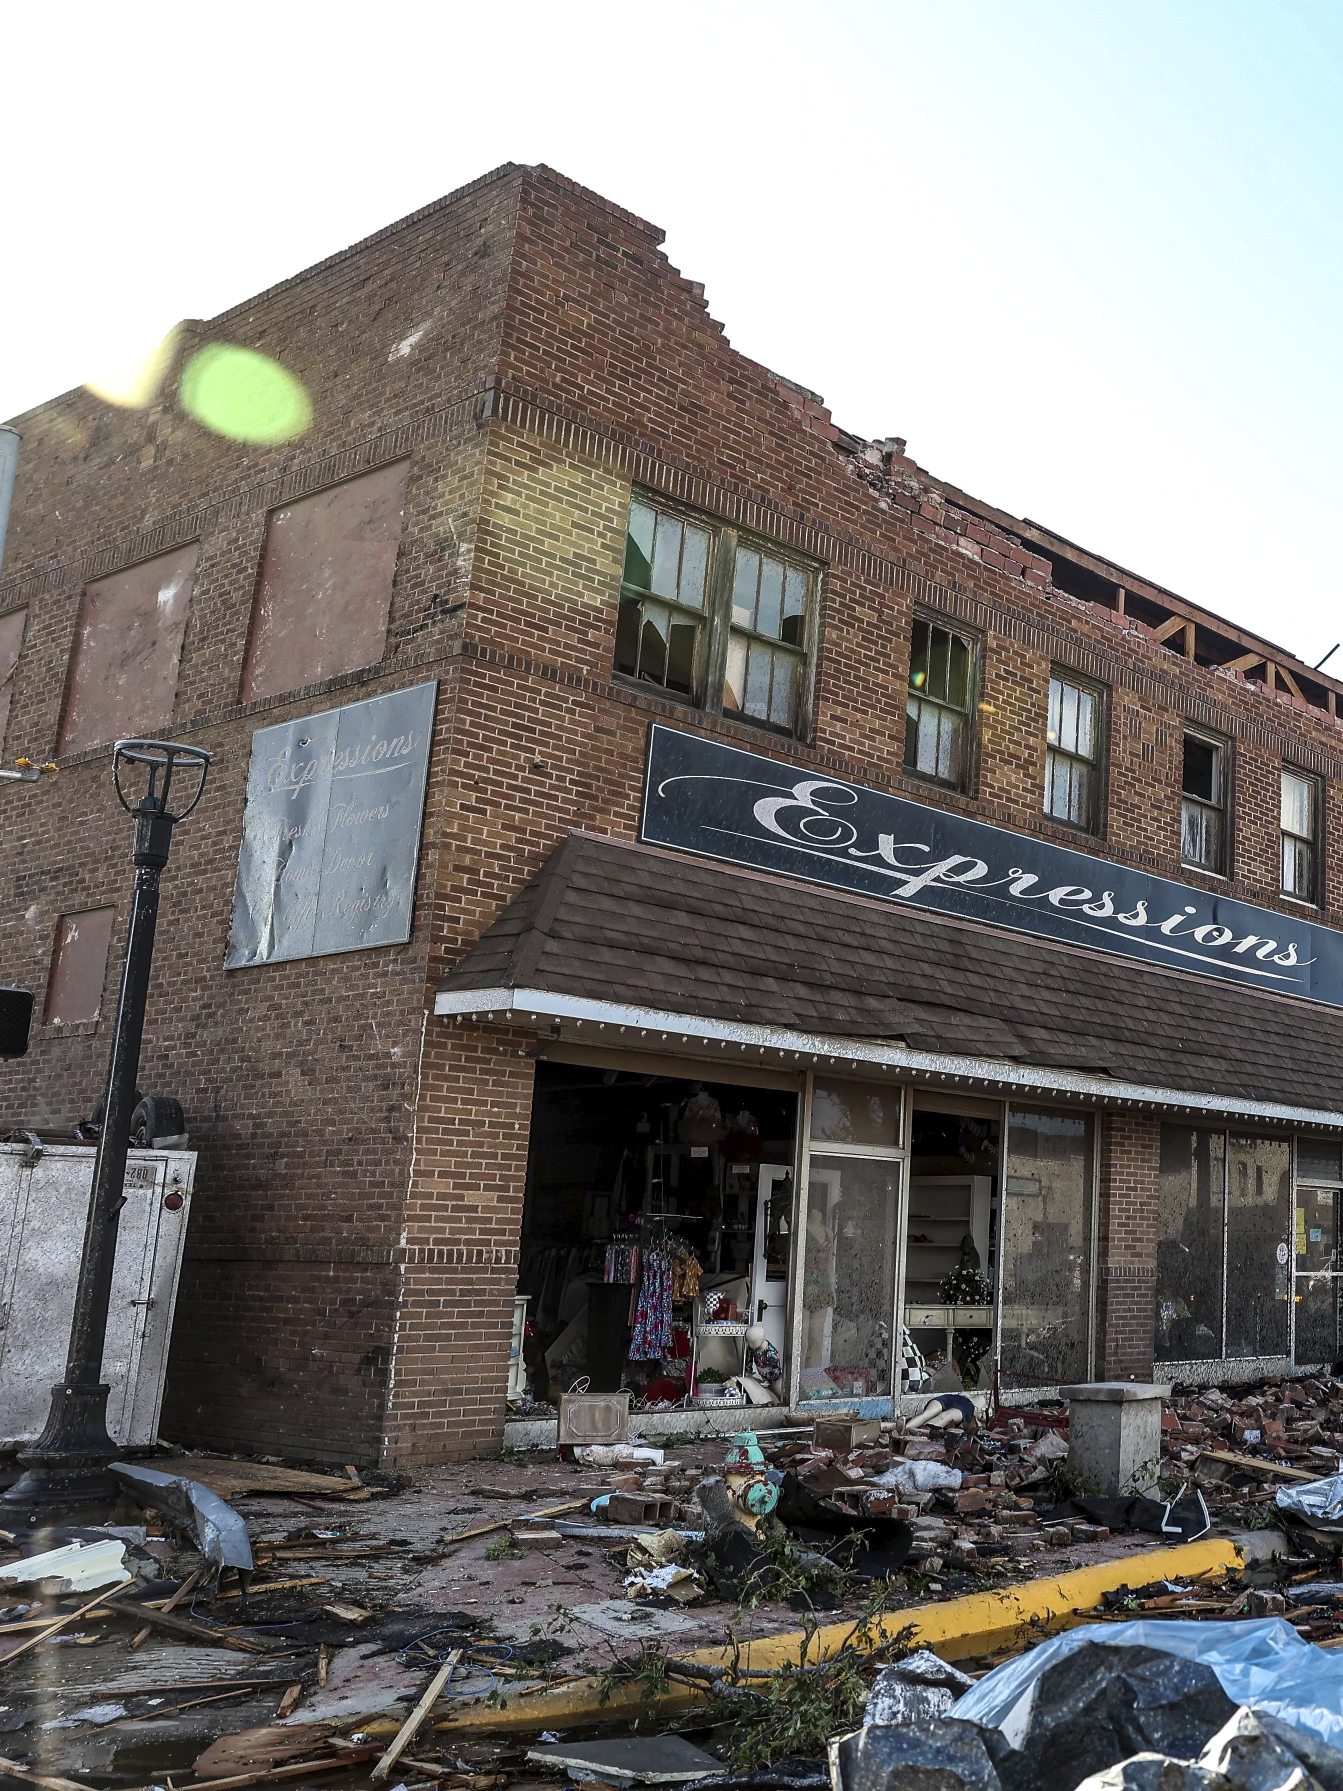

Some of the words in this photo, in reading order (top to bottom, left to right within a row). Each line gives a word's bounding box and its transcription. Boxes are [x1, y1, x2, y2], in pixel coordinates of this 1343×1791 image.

[266, 731, 421, 800] Expressions
[324, 801, 390, 834] Flowers
[657, 780, 1317, 968] Expressions
